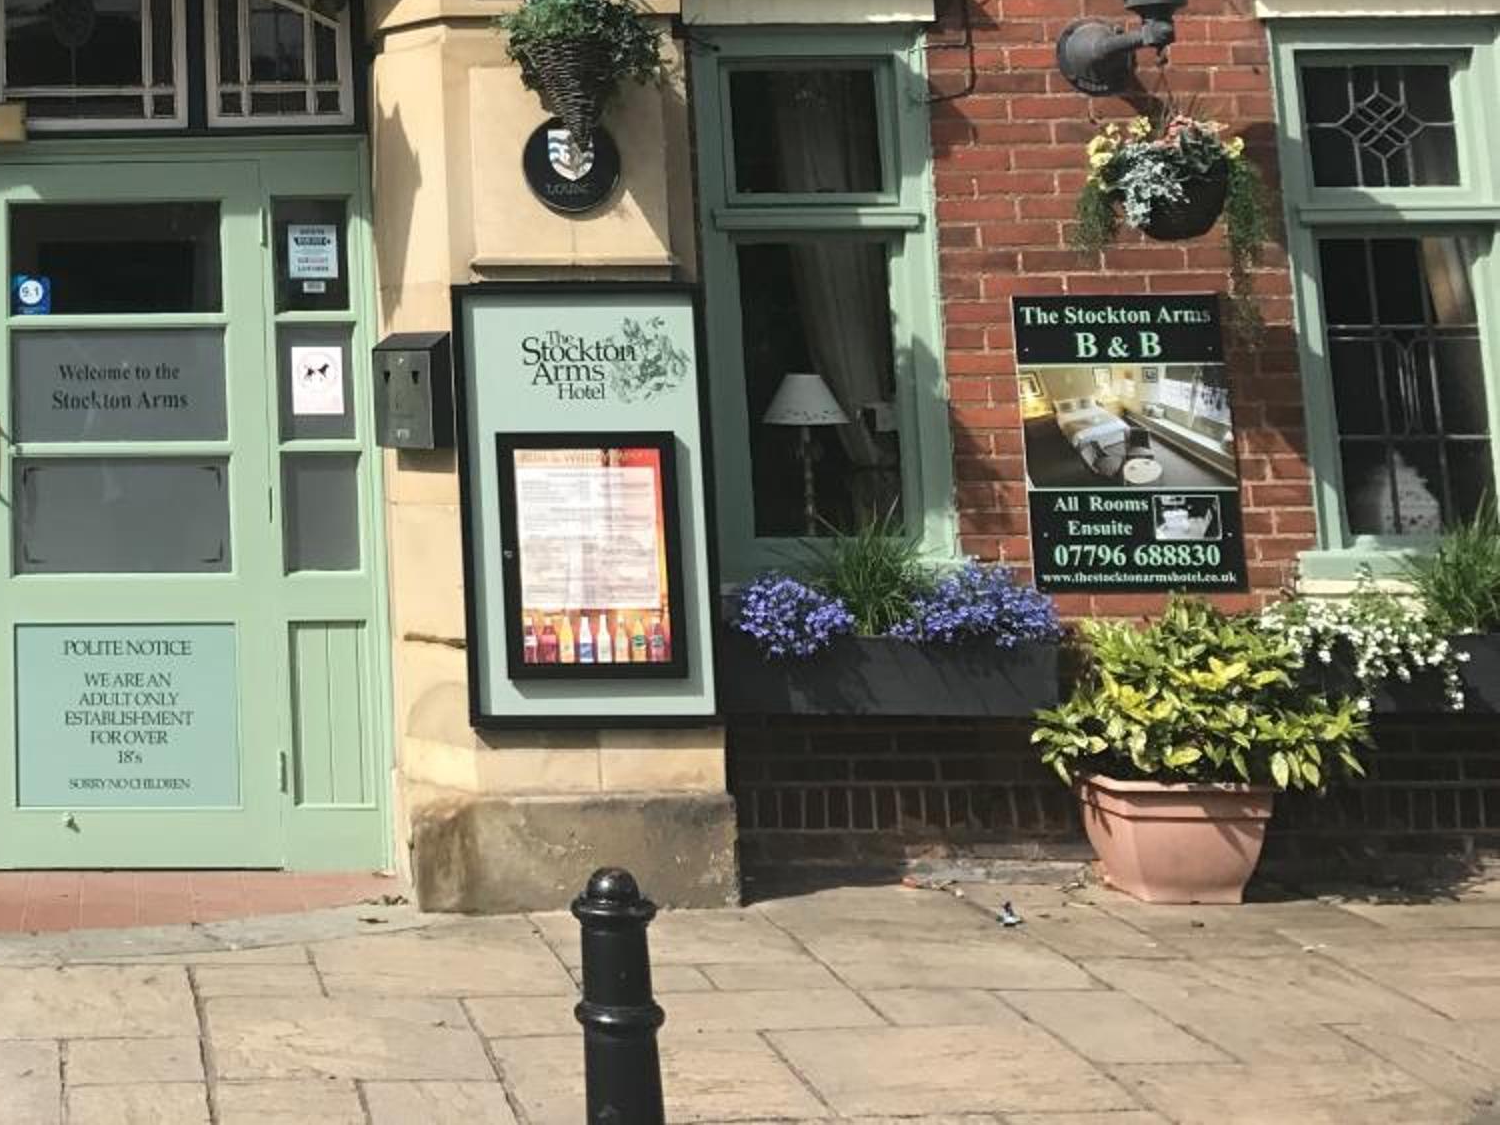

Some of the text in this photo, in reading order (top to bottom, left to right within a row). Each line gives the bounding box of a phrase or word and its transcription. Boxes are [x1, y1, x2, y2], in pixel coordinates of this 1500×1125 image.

[1020, 305, 1211, 324] The Stockton Arms
[546, 330, 574, 345] The
[1076, 331, 1162, 358] B & B
[521, 336, 637, 366] Stockton
[59, 363, 180, 380] Welcome to the
[532, 362, 605, 385] Arms
[558, 382, 605, 400] Hotel
[52, 390, 189, 410] Stockton Arms
[1054, 496, 1149, 512] All Rooms
[1068, 520, 1133, 536] Ensuite
[1054, 544, 1221, 566] 07796 688830
[64, 640, 193, 656] POLITE NOTICE
[84, 672, 172, 687] WE ARE AN
[79, 692, 179, 706] ADULT ONLY
[65, 711, 195, 726] ESTABLISHMENT
[90, 731, 168, 745] FOR OVER
[117, 750, 143, 764] 18's
[68, 778, 191, 790] SORRY NO CHILDREN
